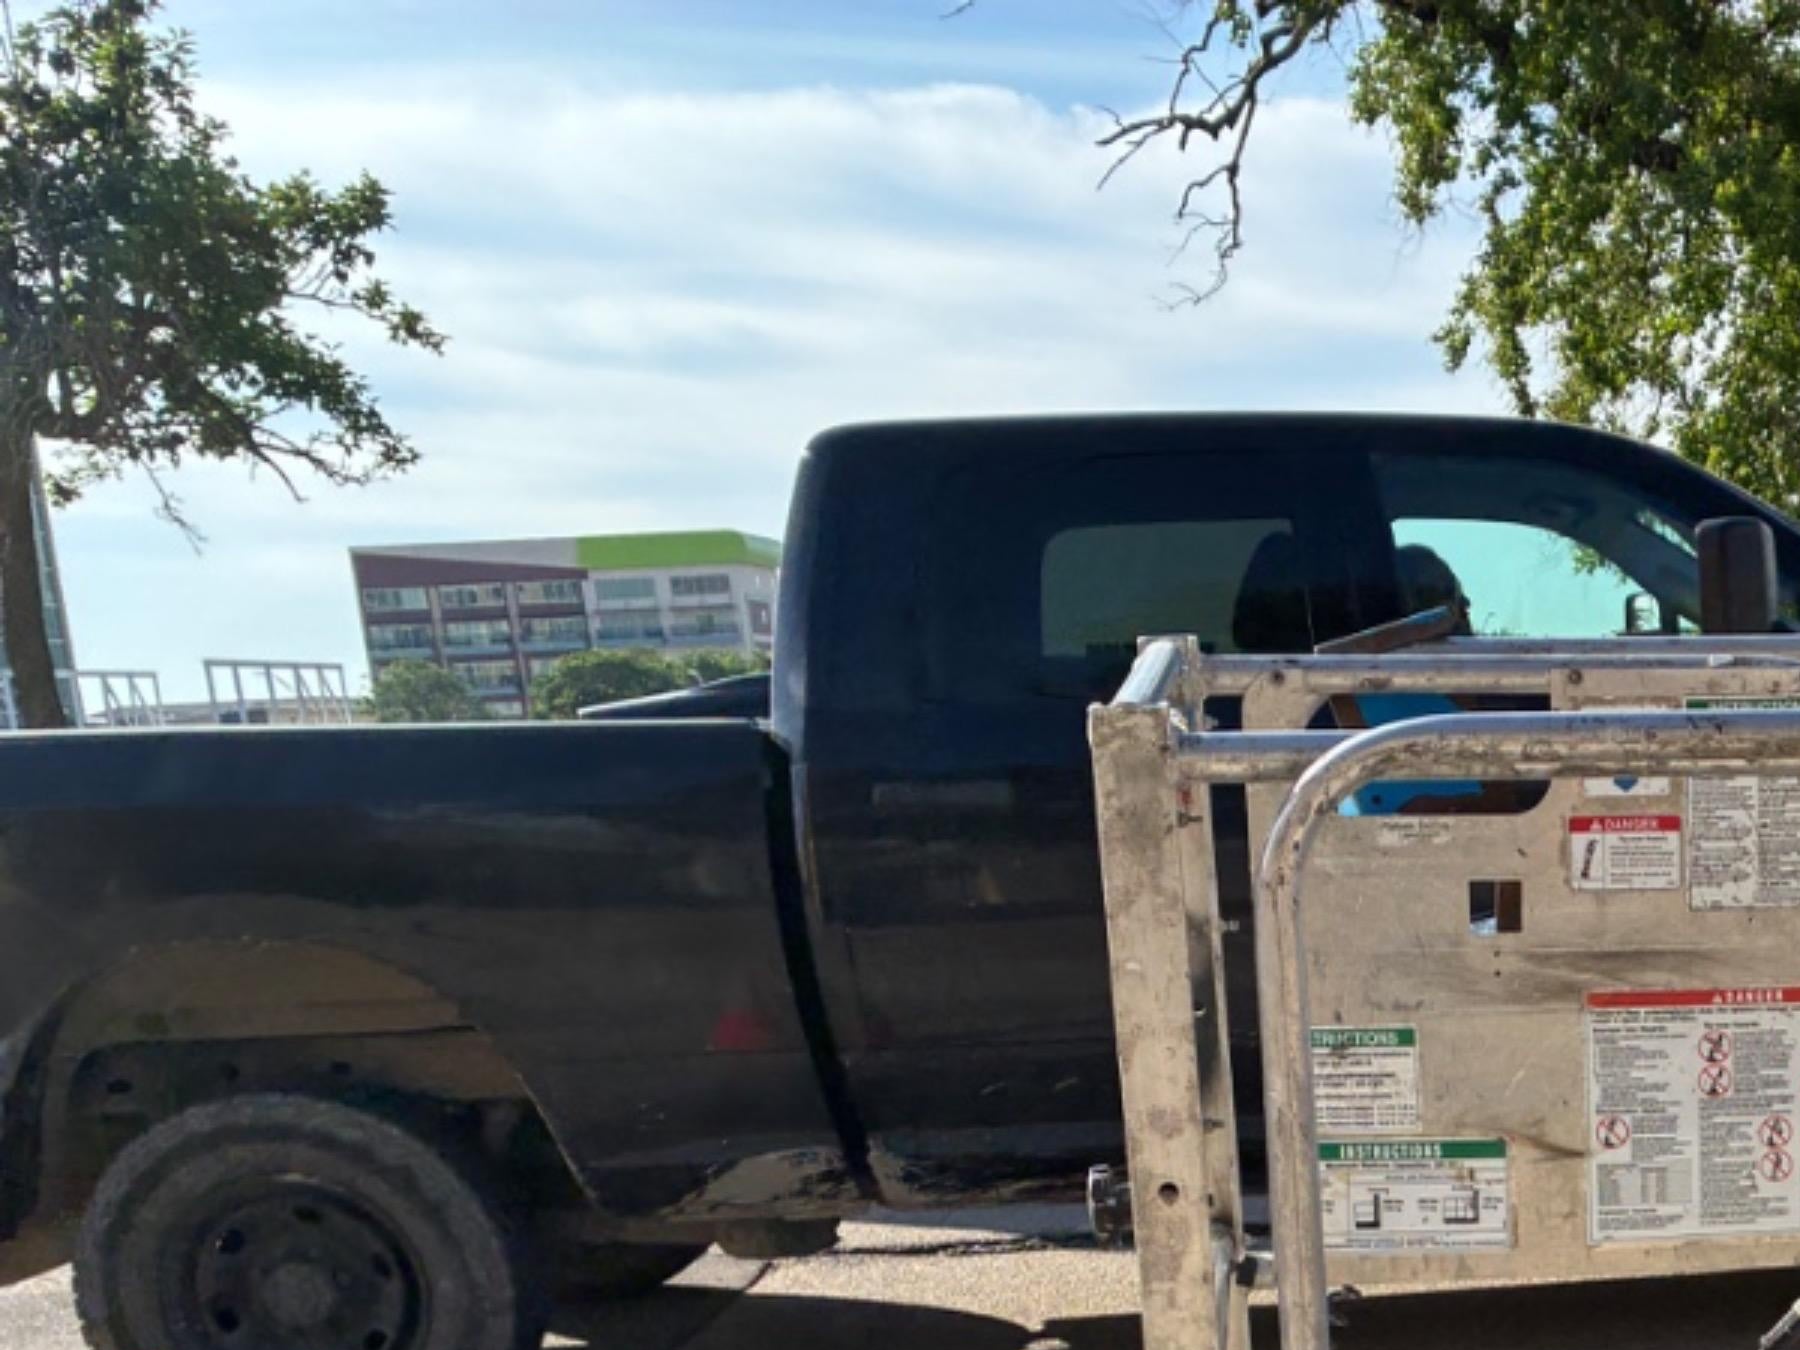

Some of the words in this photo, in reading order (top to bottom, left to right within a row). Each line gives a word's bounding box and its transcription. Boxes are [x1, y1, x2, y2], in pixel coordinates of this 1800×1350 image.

[1604, 817, 1659, 831] DANGER
[1727, 990, 1783, 1004] DANGER
[1341, 1143, 1441, 1160] INSTRUCTIONS
